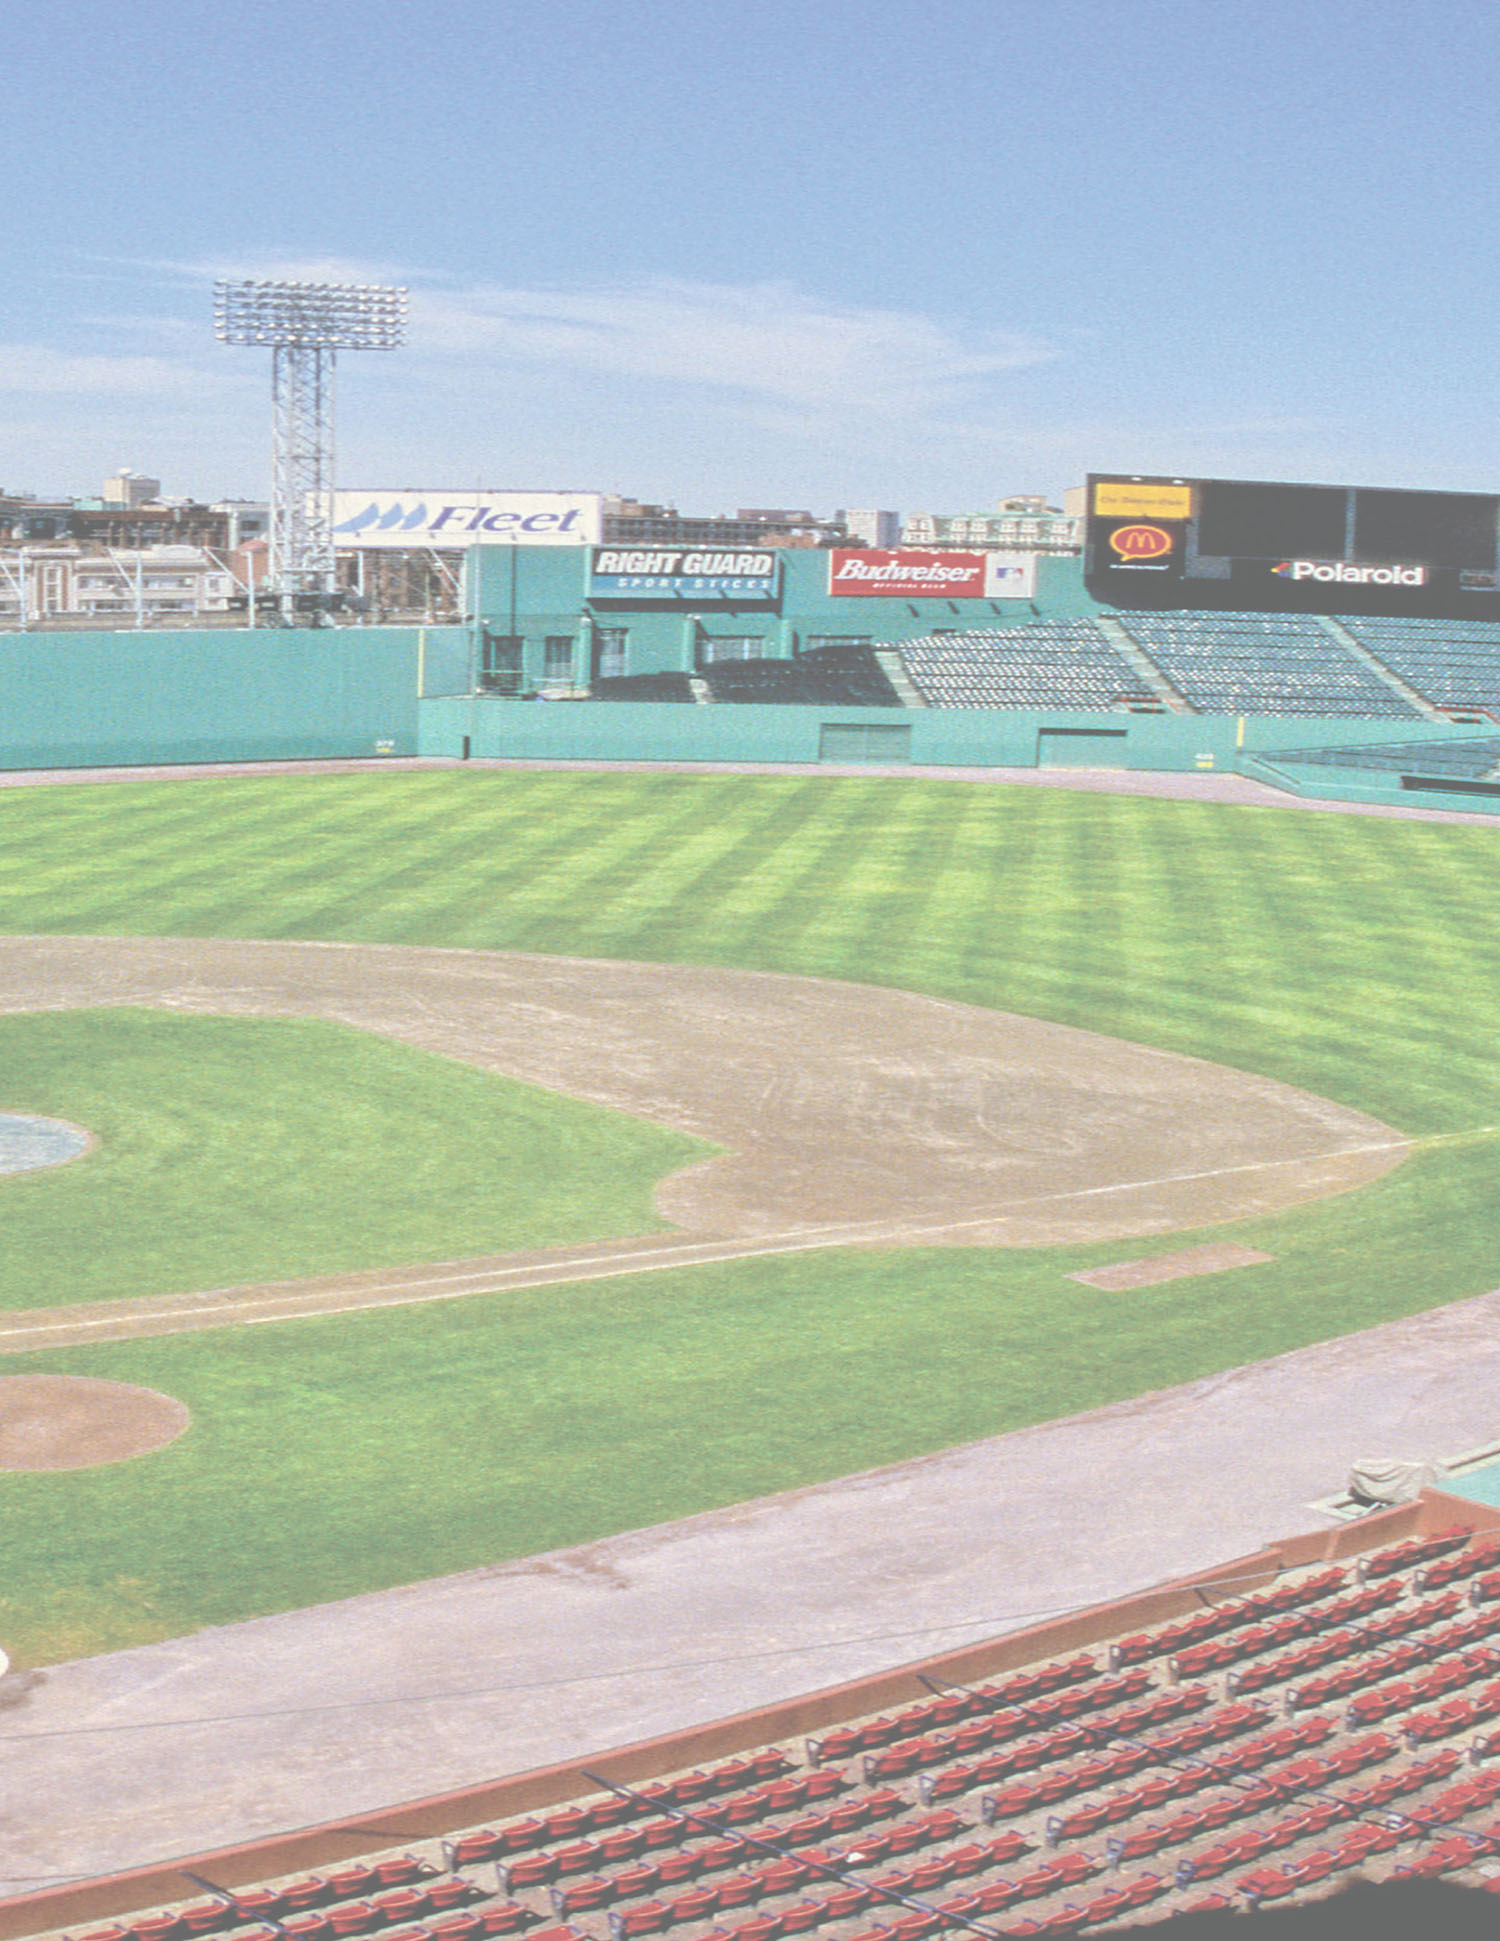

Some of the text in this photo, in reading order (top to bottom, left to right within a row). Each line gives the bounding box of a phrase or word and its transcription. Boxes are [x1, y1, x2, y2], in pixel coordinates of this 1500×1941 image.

[428, 506, 582, 531] Fleet
[595, 551, 772, 575] RIGHT GUARD
[834, 559, 980, 582] Budweiser
[1292, 561, 1424, 586] Polaroid
[617, 577, 771, 589] SPORT STICKS
